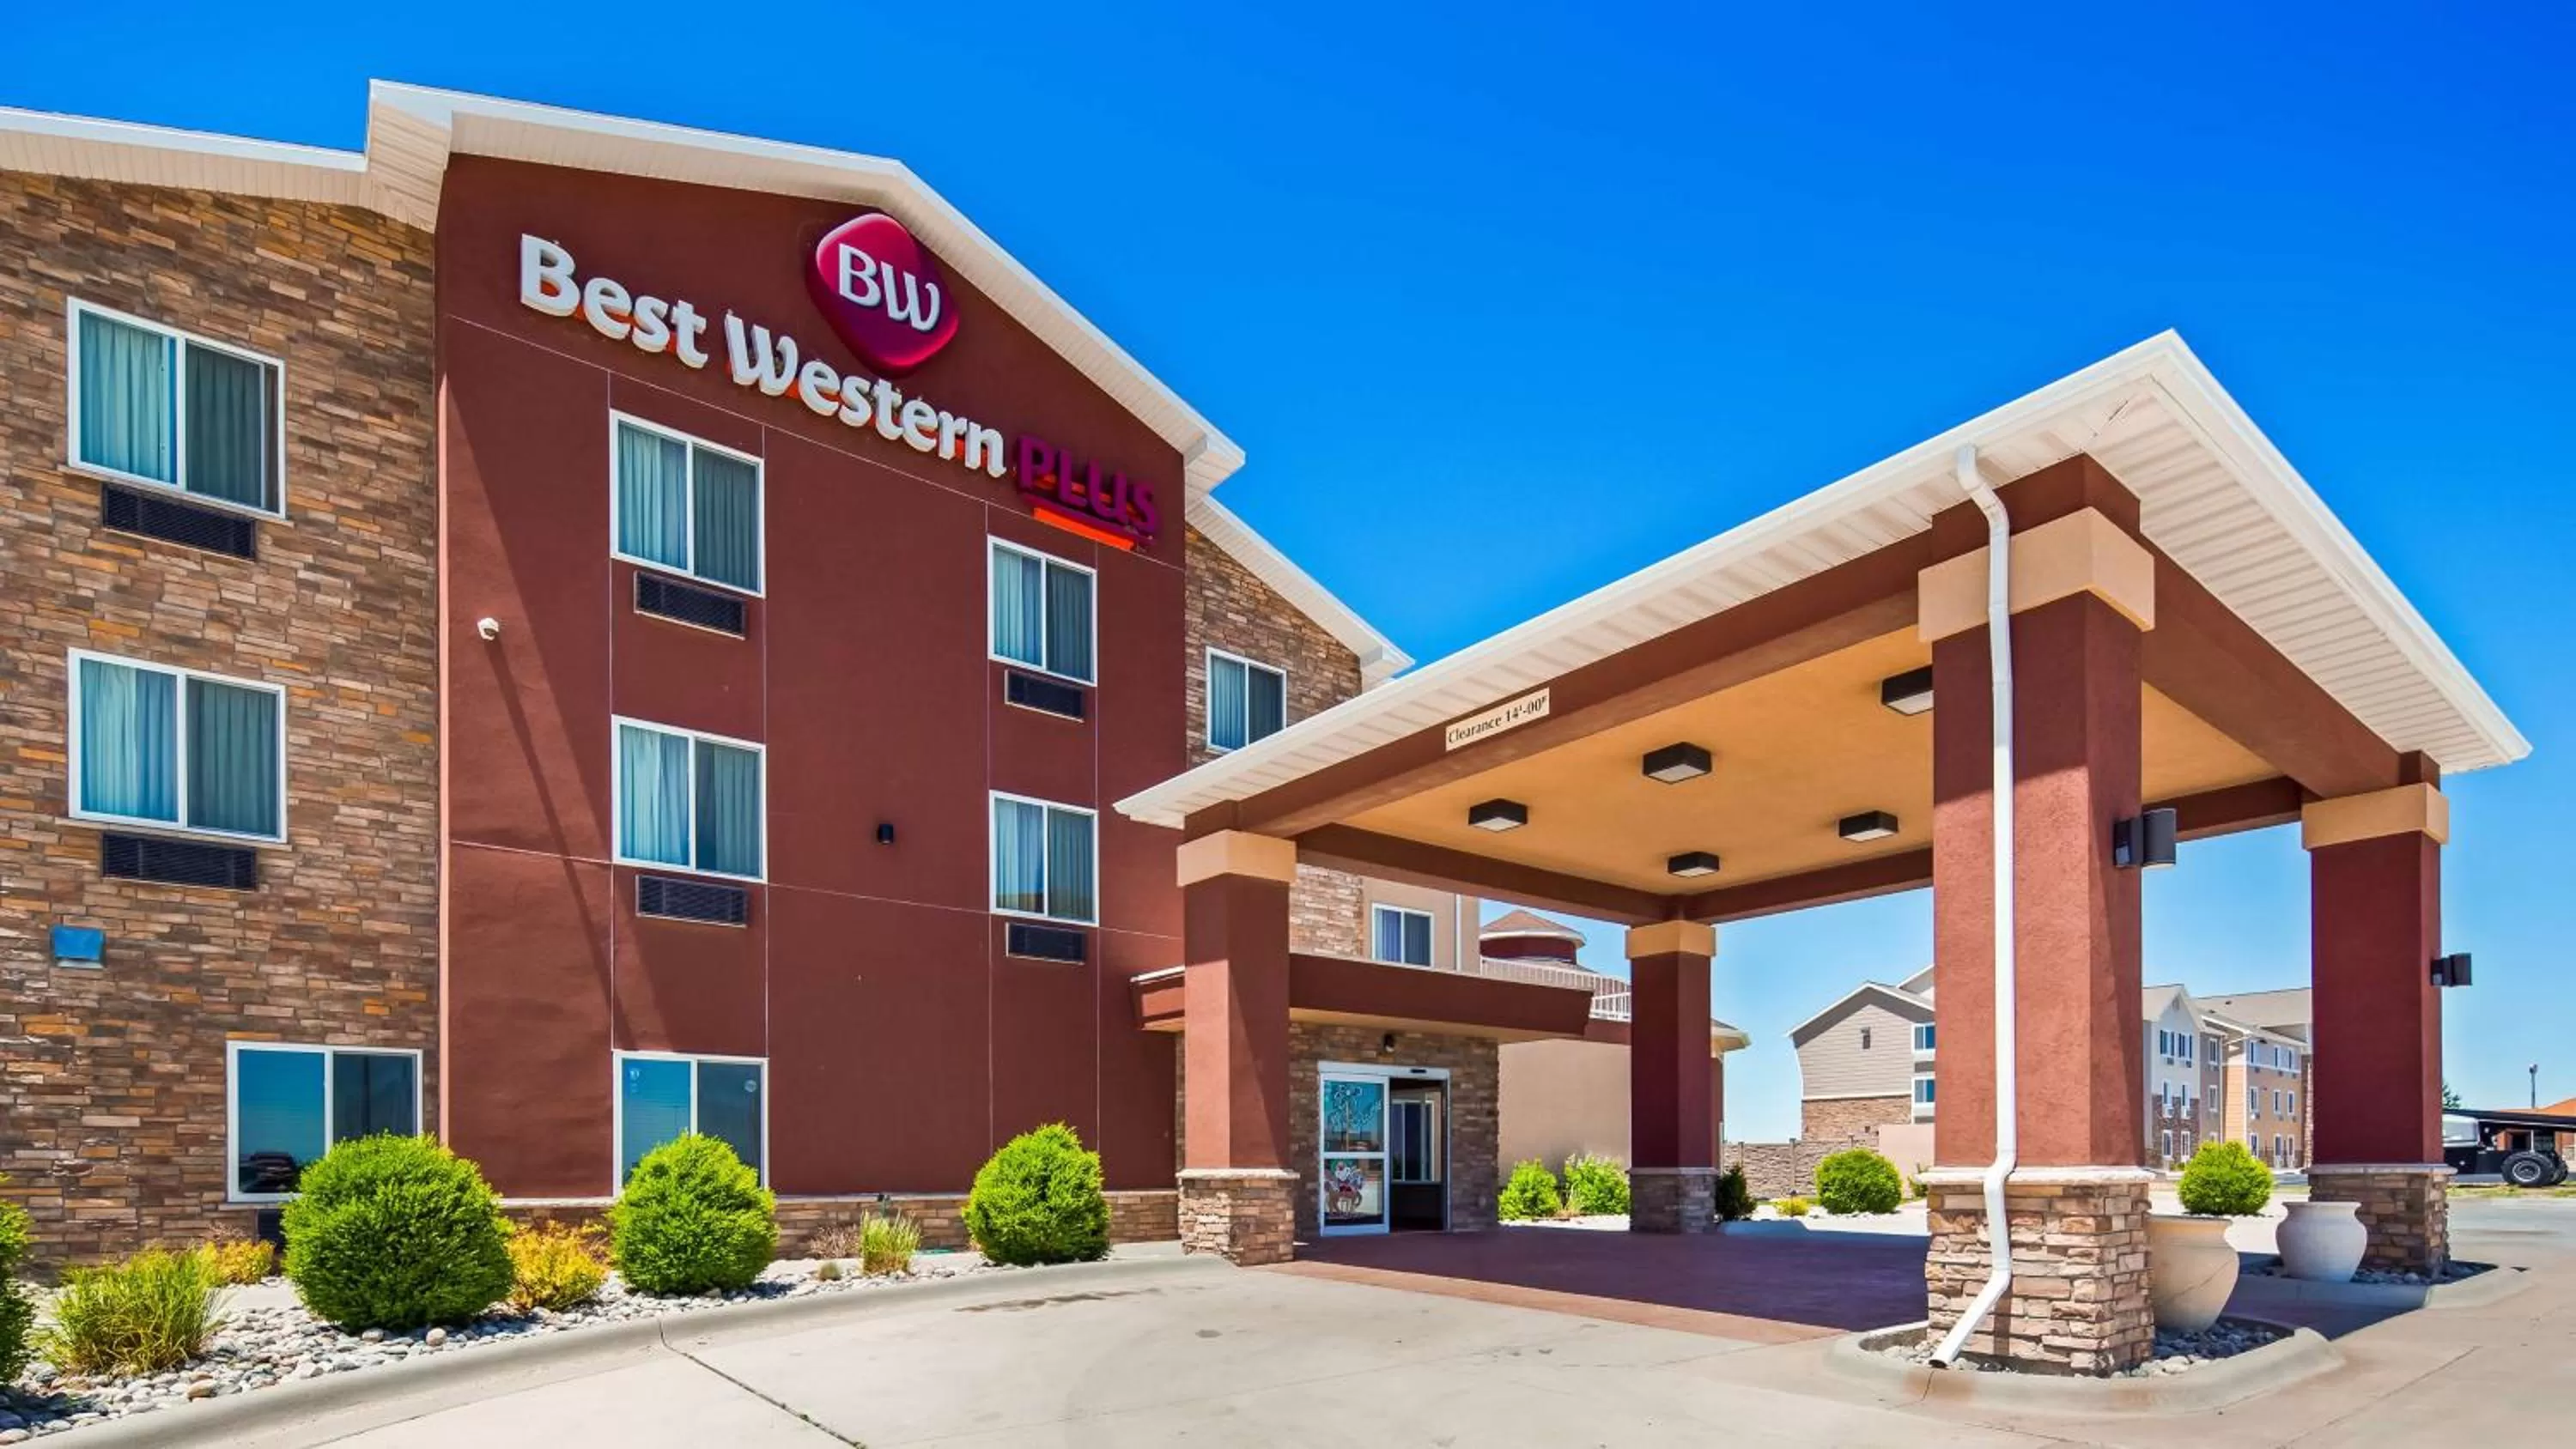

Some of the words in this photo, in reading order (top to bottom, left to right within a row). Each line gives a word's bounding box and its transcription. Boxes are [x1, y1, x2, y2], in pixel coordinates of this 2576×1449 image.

[838, 244, 941, 331] BW
[520, 233, 708, 369] Best
[725, 312, 1007, 477] Western
[1017, 435, 1157, 530] PLUS
[1448, 716, 1502, 743] Clearance
